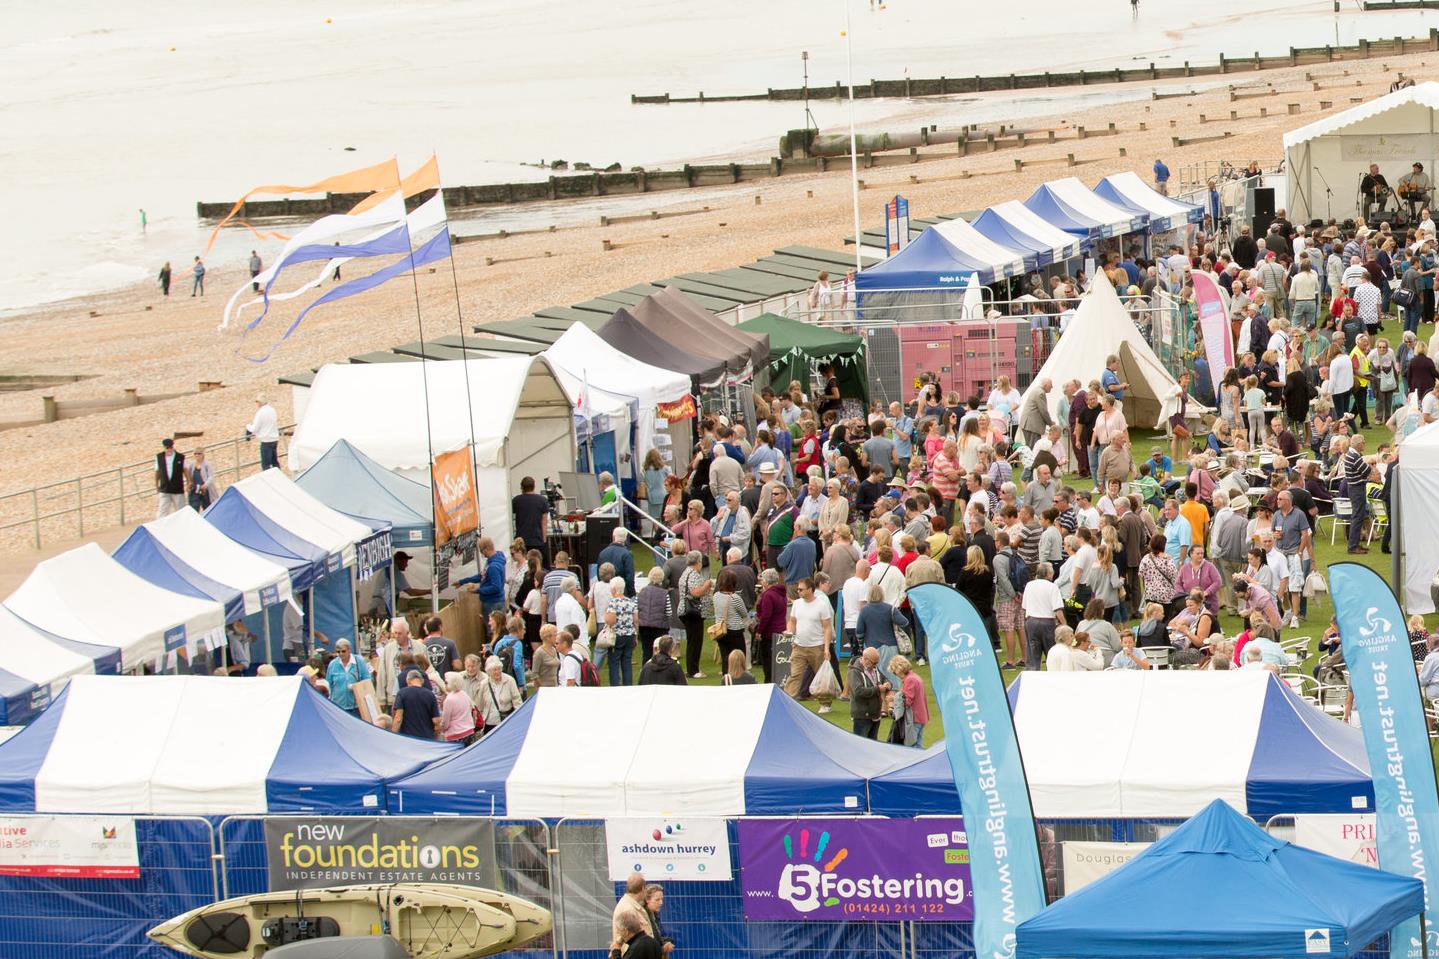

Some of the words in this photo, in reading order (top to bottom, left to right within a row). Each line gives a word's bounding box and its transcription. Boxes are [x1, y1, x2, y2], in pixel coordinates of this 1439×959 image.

[0, 825, 28, 836] tive
[297, 824, 345, 841] new
[1342, 824, 1375, 840] PRI
[930, 836, 947, 844] Ever
[280, 832, 480, 869] foundations
[622, 843, 674, 854] ashdown
[676, 843, 717, 856] hurrey
[286, 872, 373, 881] INDEPENDENT
[379, 872, 424, 881] ESTATE
[430, 872, 481, 881] AGENTS
[746, 890, 774, 898] www.
[843, 903, 891, 915] (01424)
[895, 903, 917, 914] 211
[921, 903, 945, 914] 122
